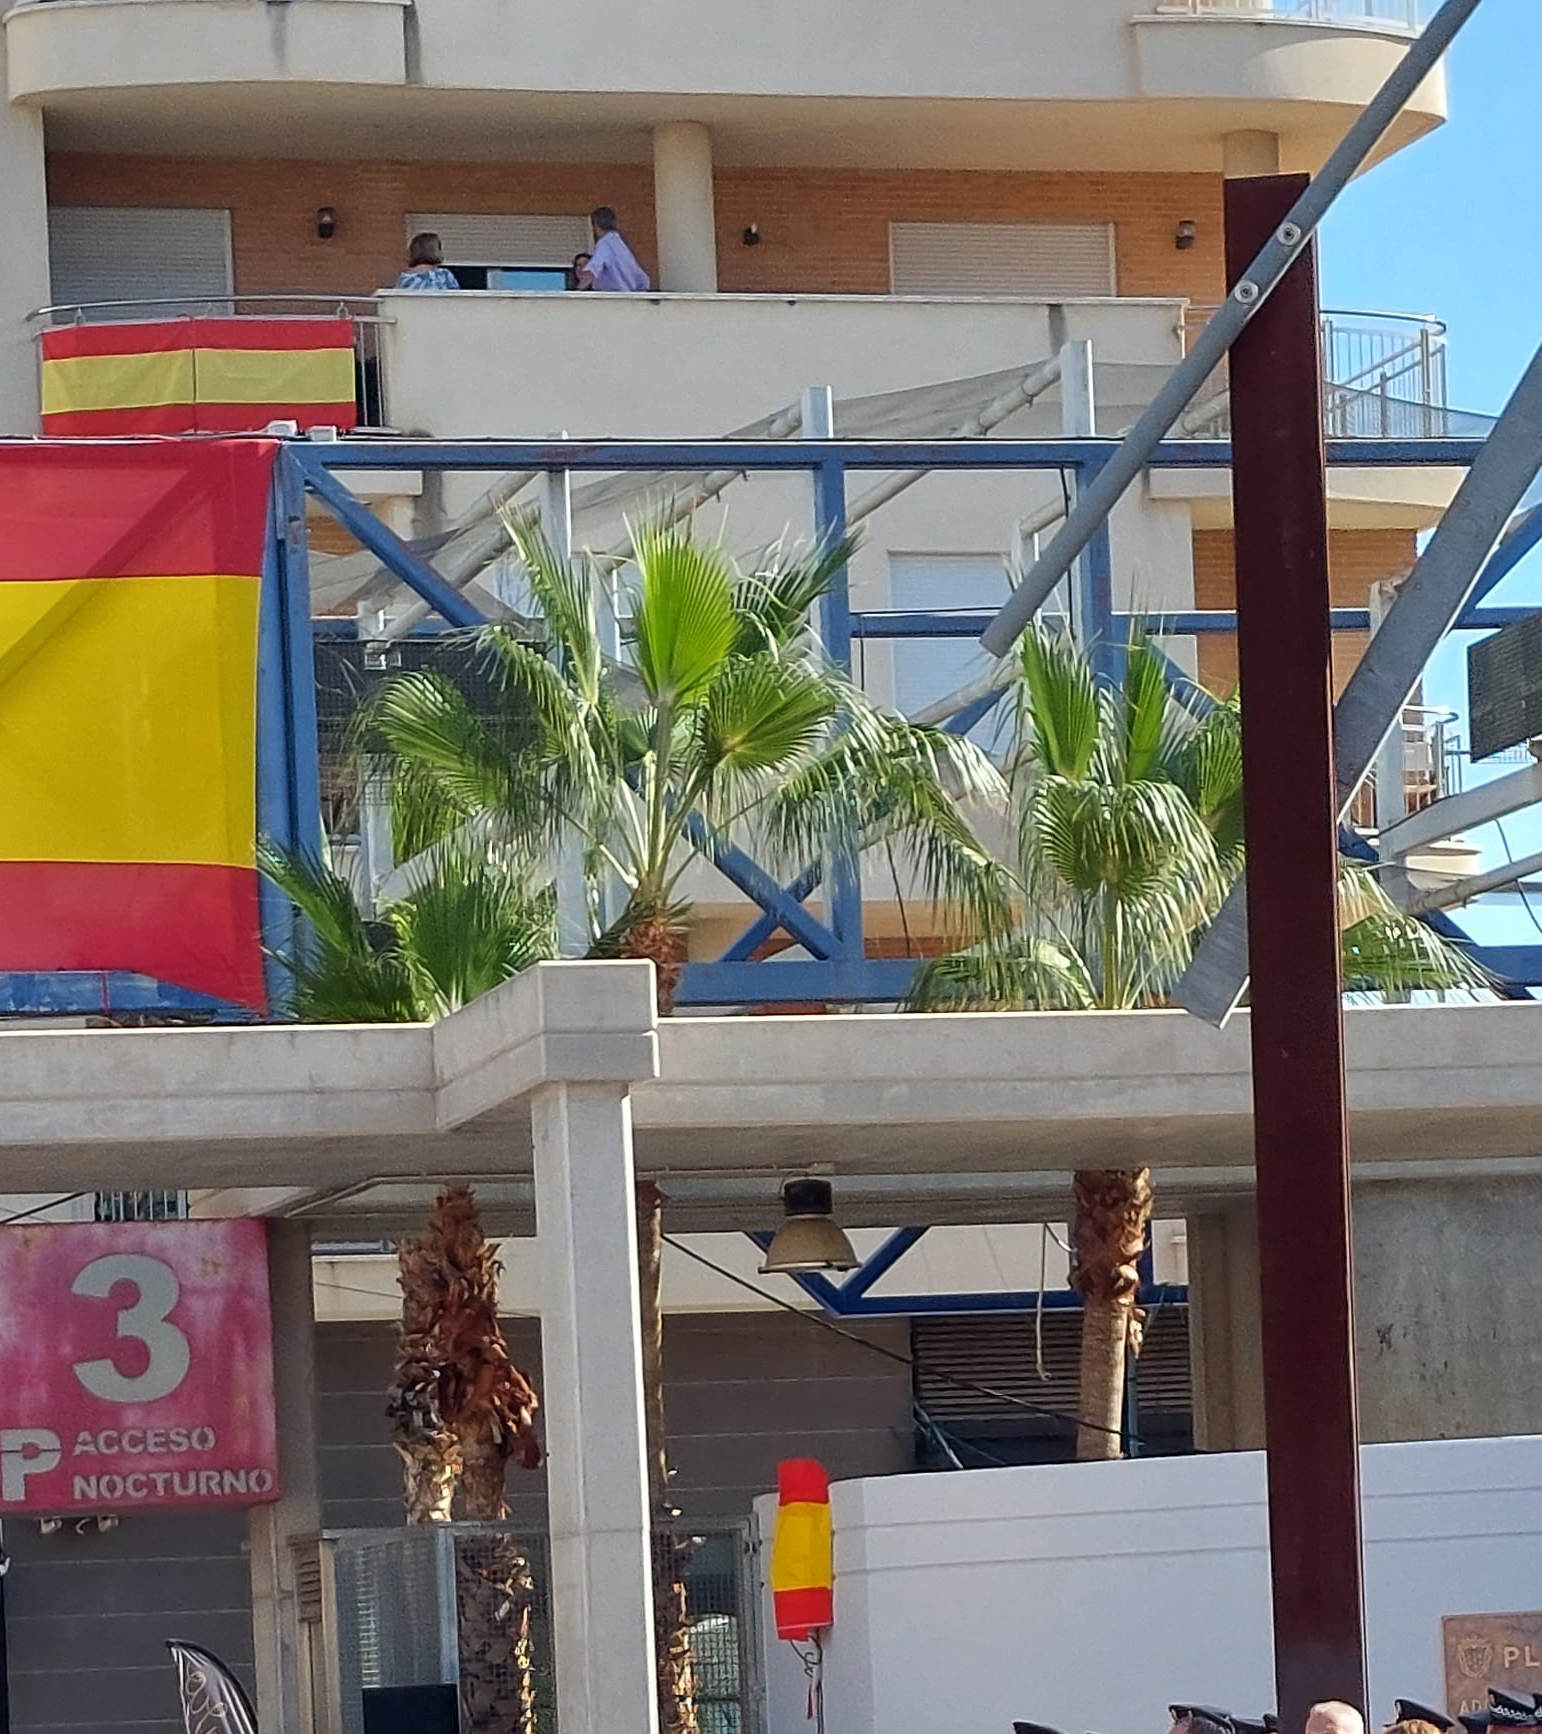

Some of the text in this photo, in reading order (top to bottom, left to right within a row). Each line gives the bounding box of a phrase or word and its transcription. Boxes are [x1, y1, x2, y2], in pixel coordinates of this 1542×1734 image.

[71, 1252, 190, 1403] 3
[0, 1428, 61, 1501] P
[73, 1426, 216, 1456] ACCESO
[73, 1468, 273, 1500] NOCTURNO
